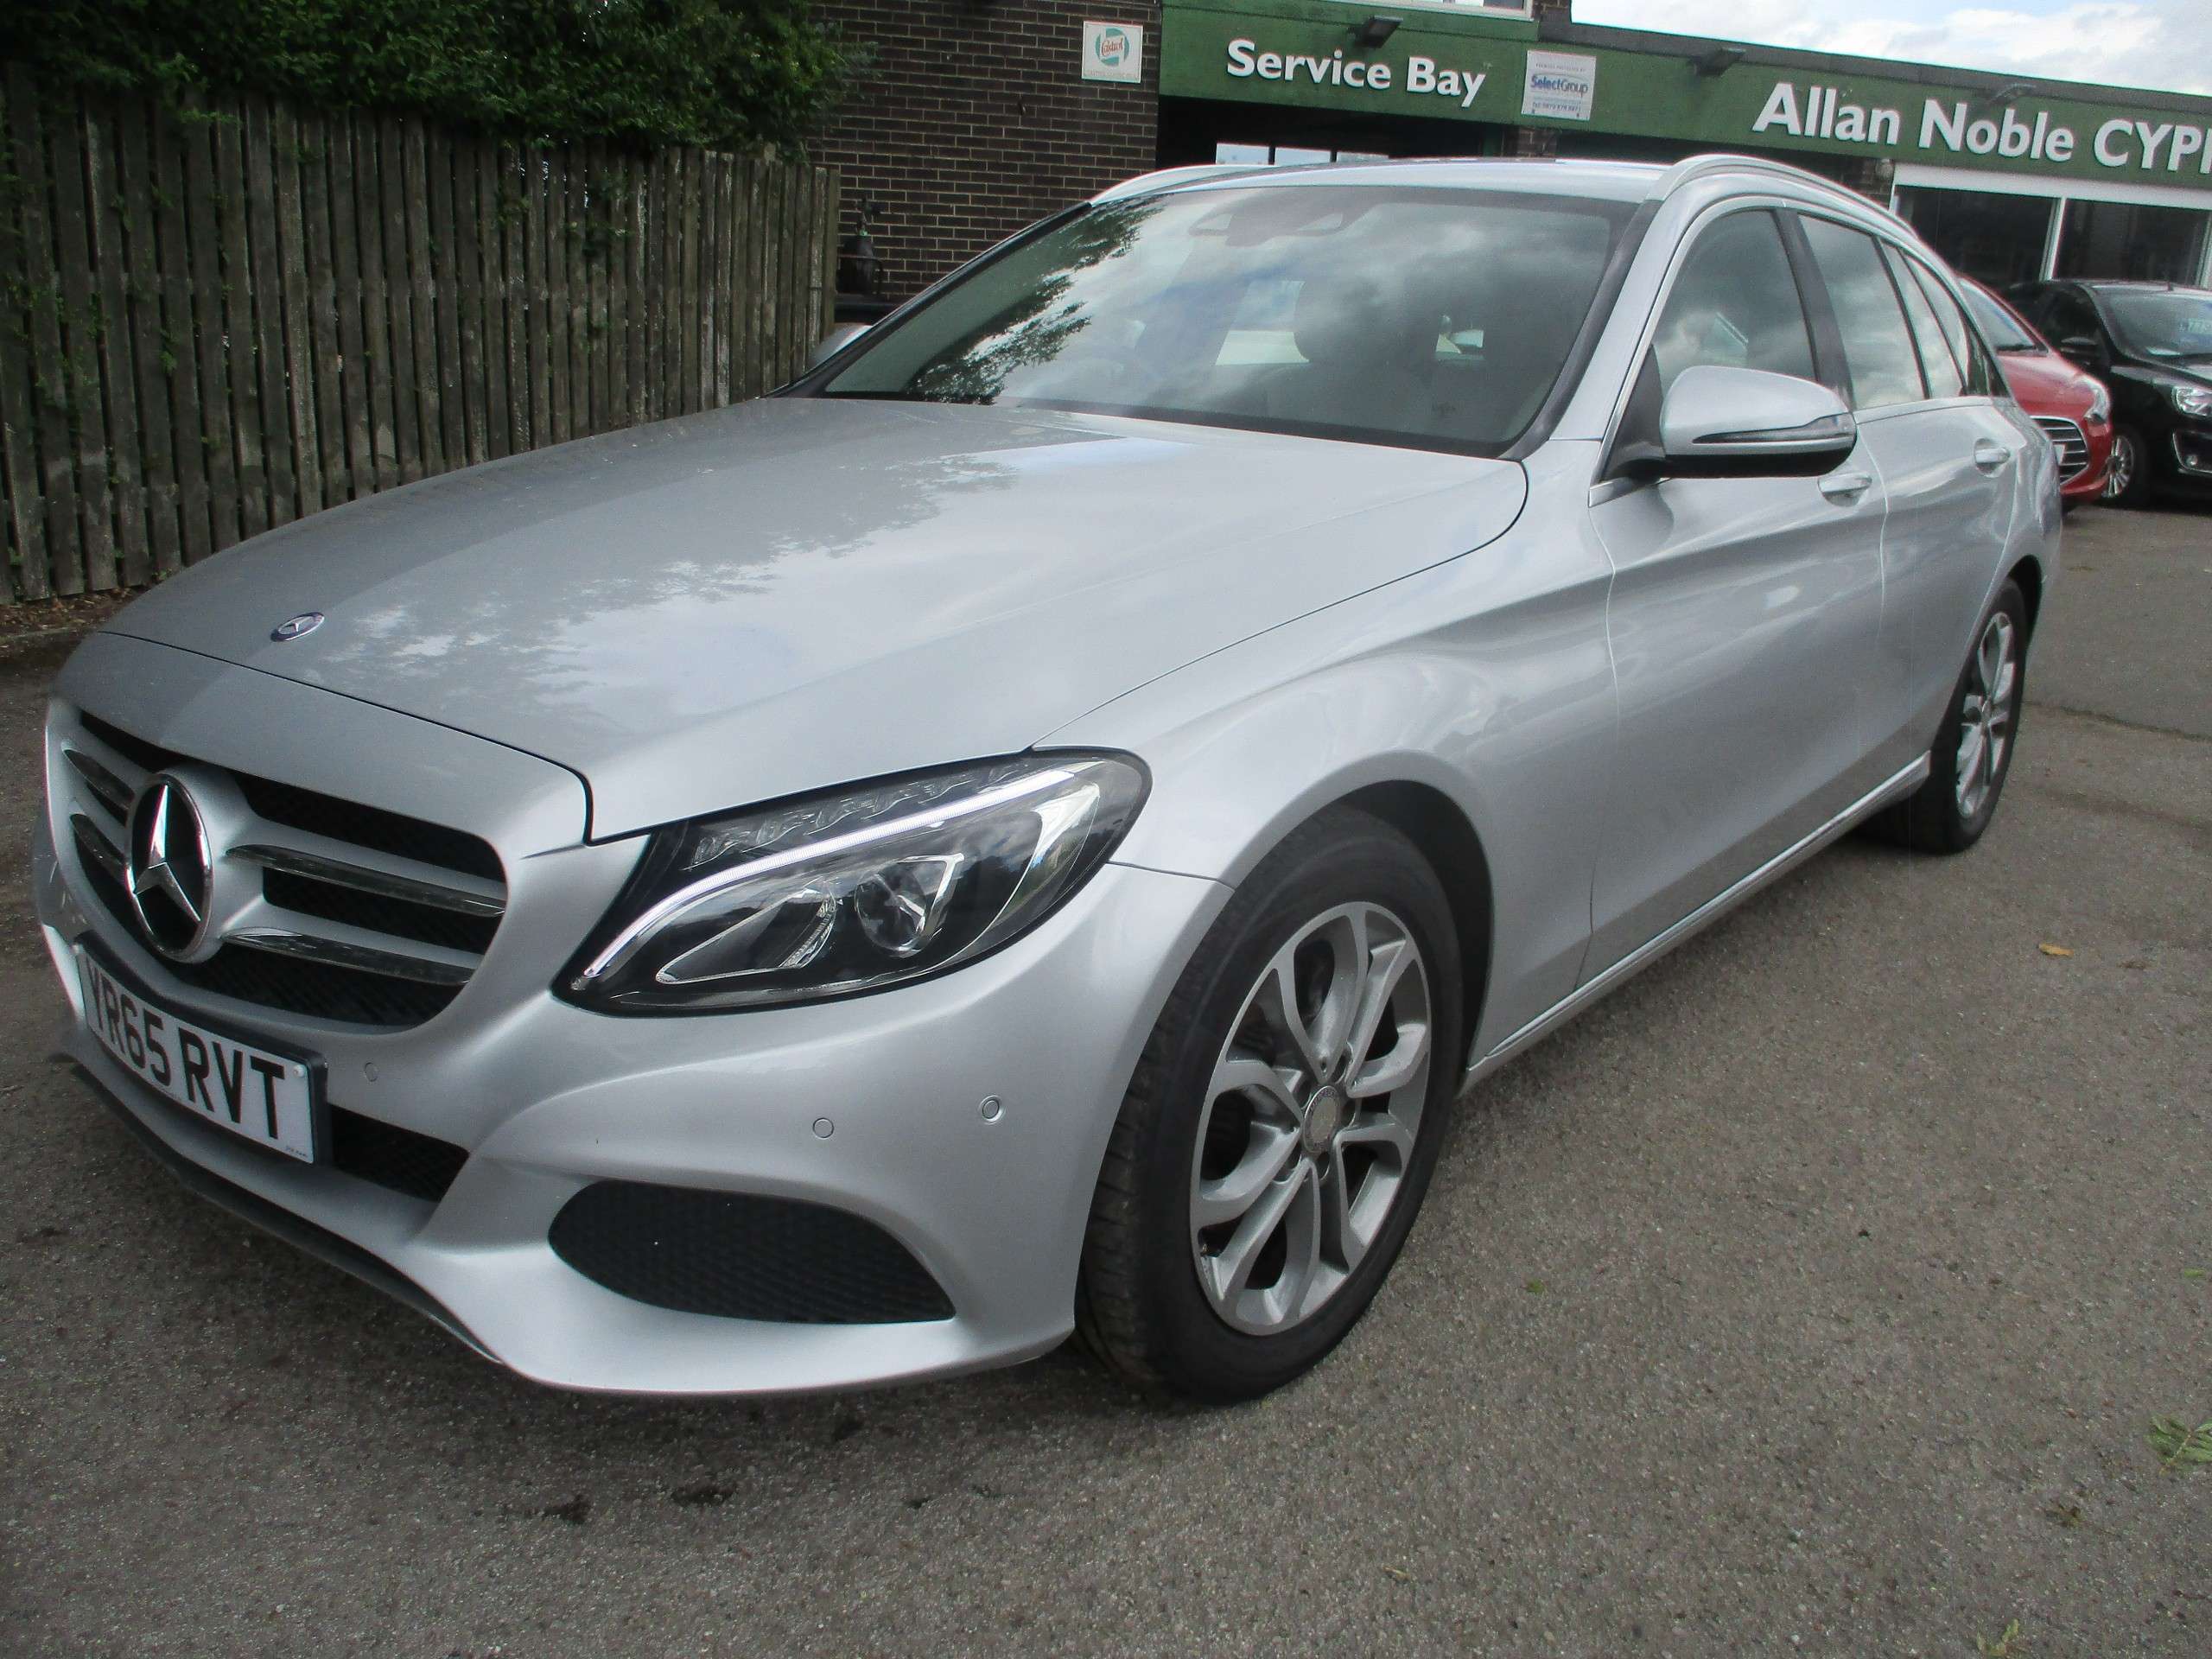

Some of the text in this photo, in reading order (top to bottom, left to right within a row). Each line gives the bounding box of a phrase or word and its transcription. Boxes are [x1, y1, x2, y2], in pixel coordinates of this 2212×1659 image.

[1227, 38, 1486, 108] Service Bay
[1751, 82, 1901, 146] Allan
[1917, 99, 2075, 162] Noble
[86, 957, 286, 1141] YR65 RVT
